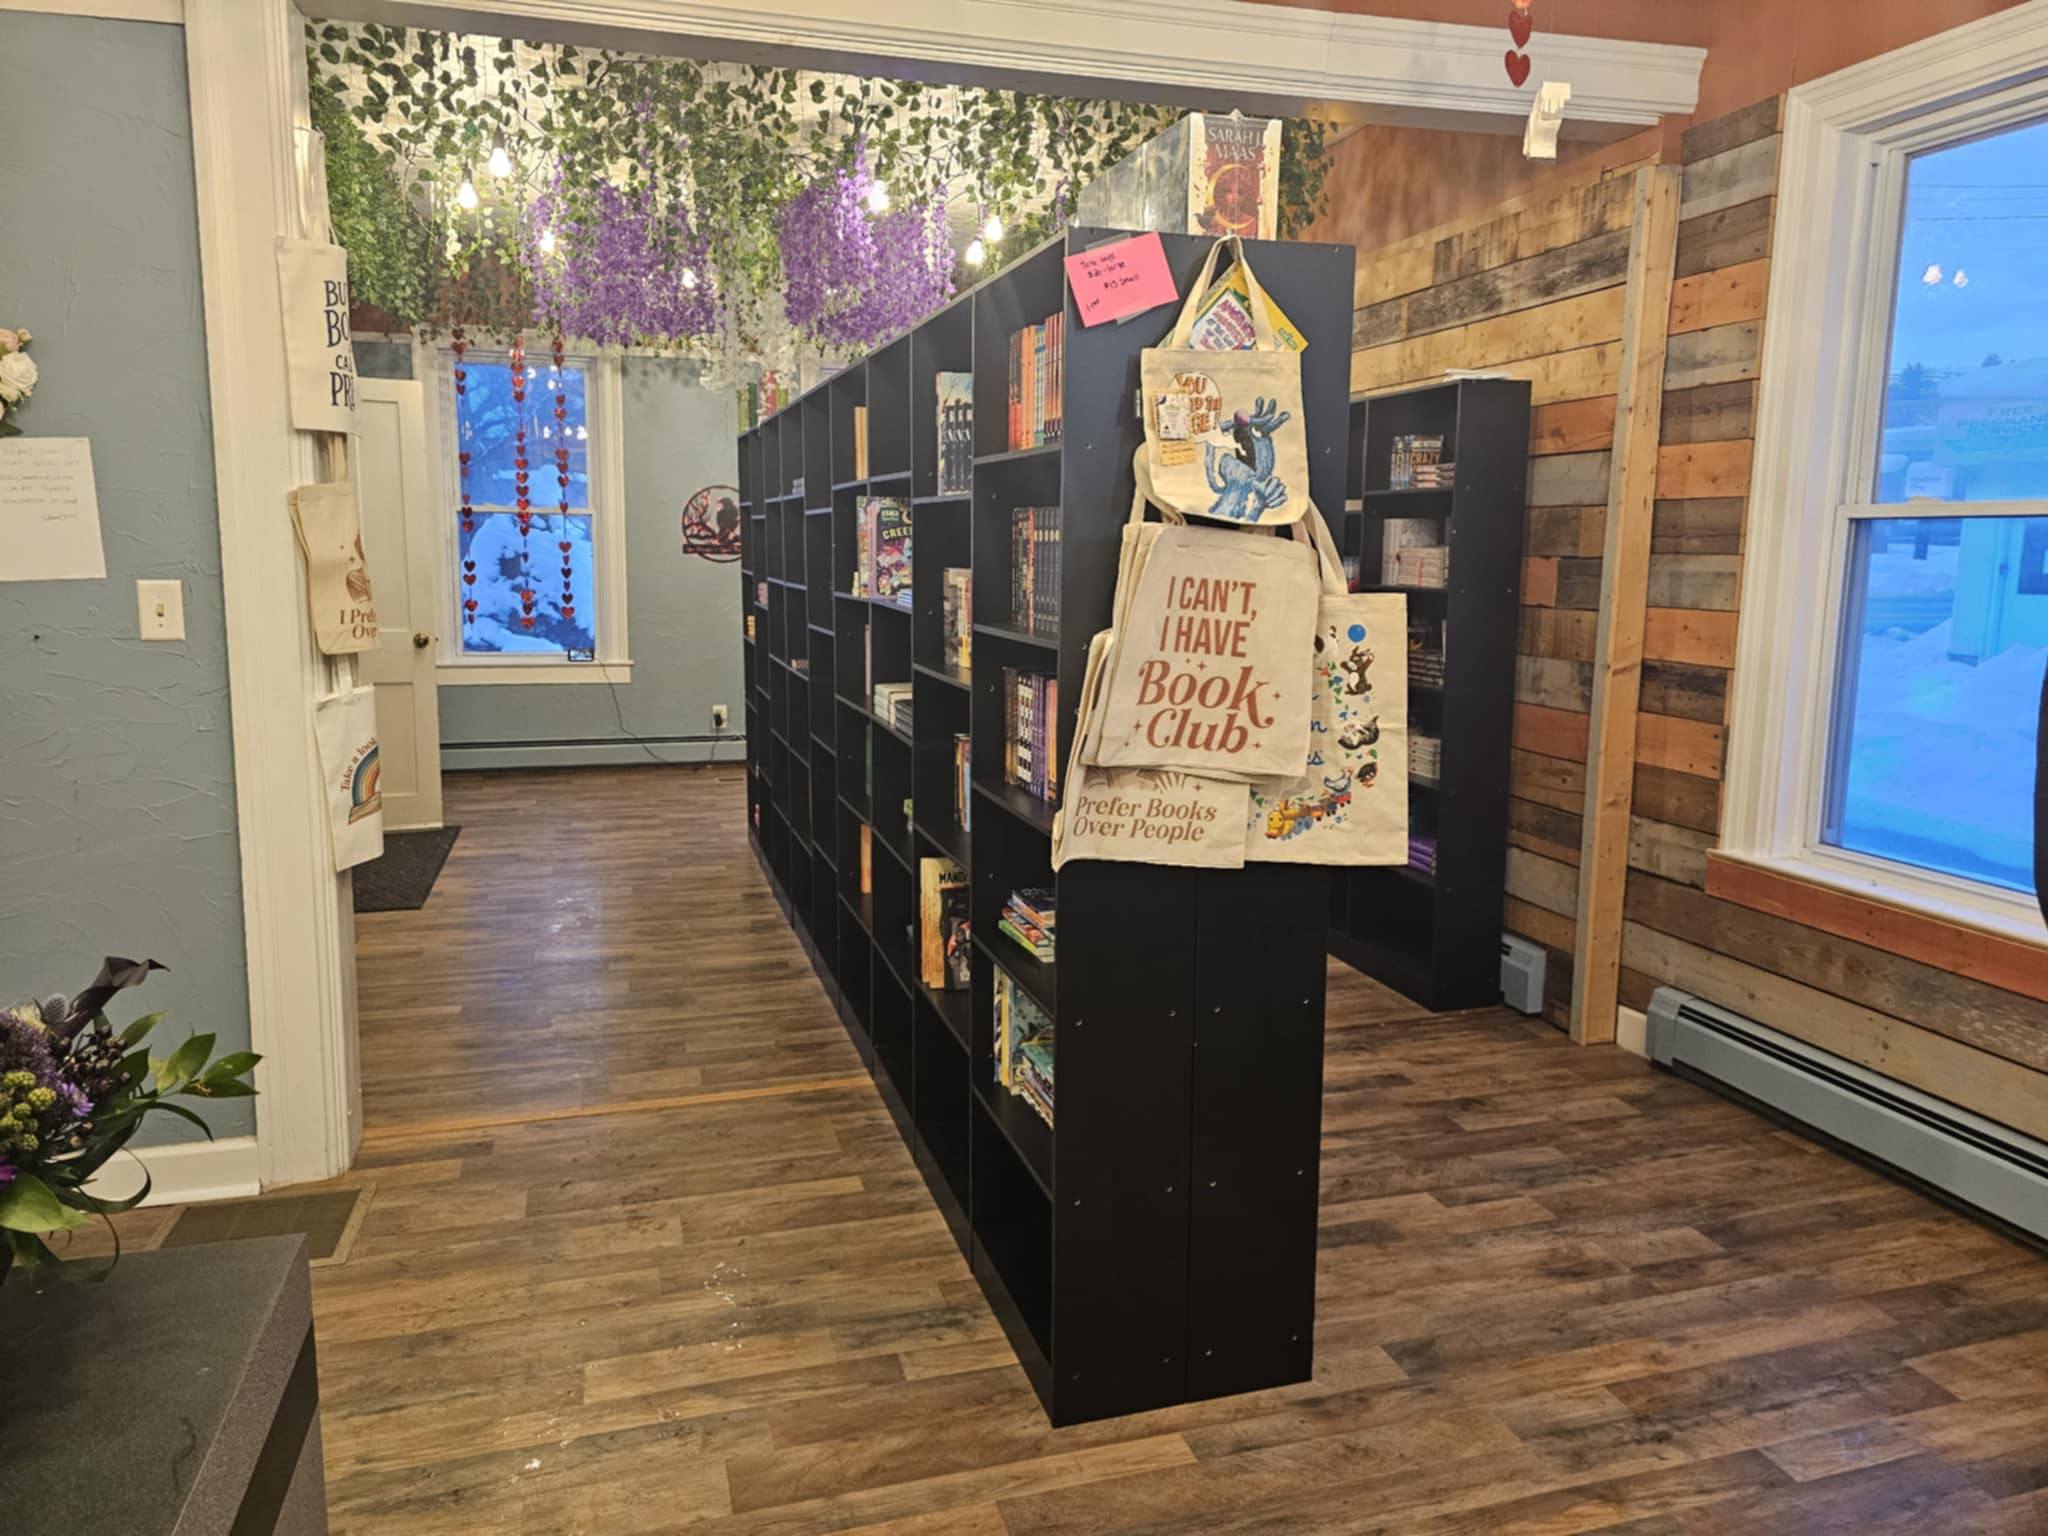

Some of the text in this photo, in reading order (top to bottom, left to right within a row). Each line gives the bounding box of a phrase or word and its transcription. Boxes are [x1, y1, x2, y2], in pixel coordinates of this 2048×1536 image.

[1207, 127, 1253, 145] SARAH
[1214, 143, 1257, 160] MAAS
[1166, 576, 1257, 621] I CAN'T,
[1159, 615, 1251, 658] I HAVE
[1136, 660, 1275, 729] Book
[1146, 708, 1249, 754] Club
[1076, 796, 1217, 822] Prefer Books
[1073, 816, 1205, 844] Over People
